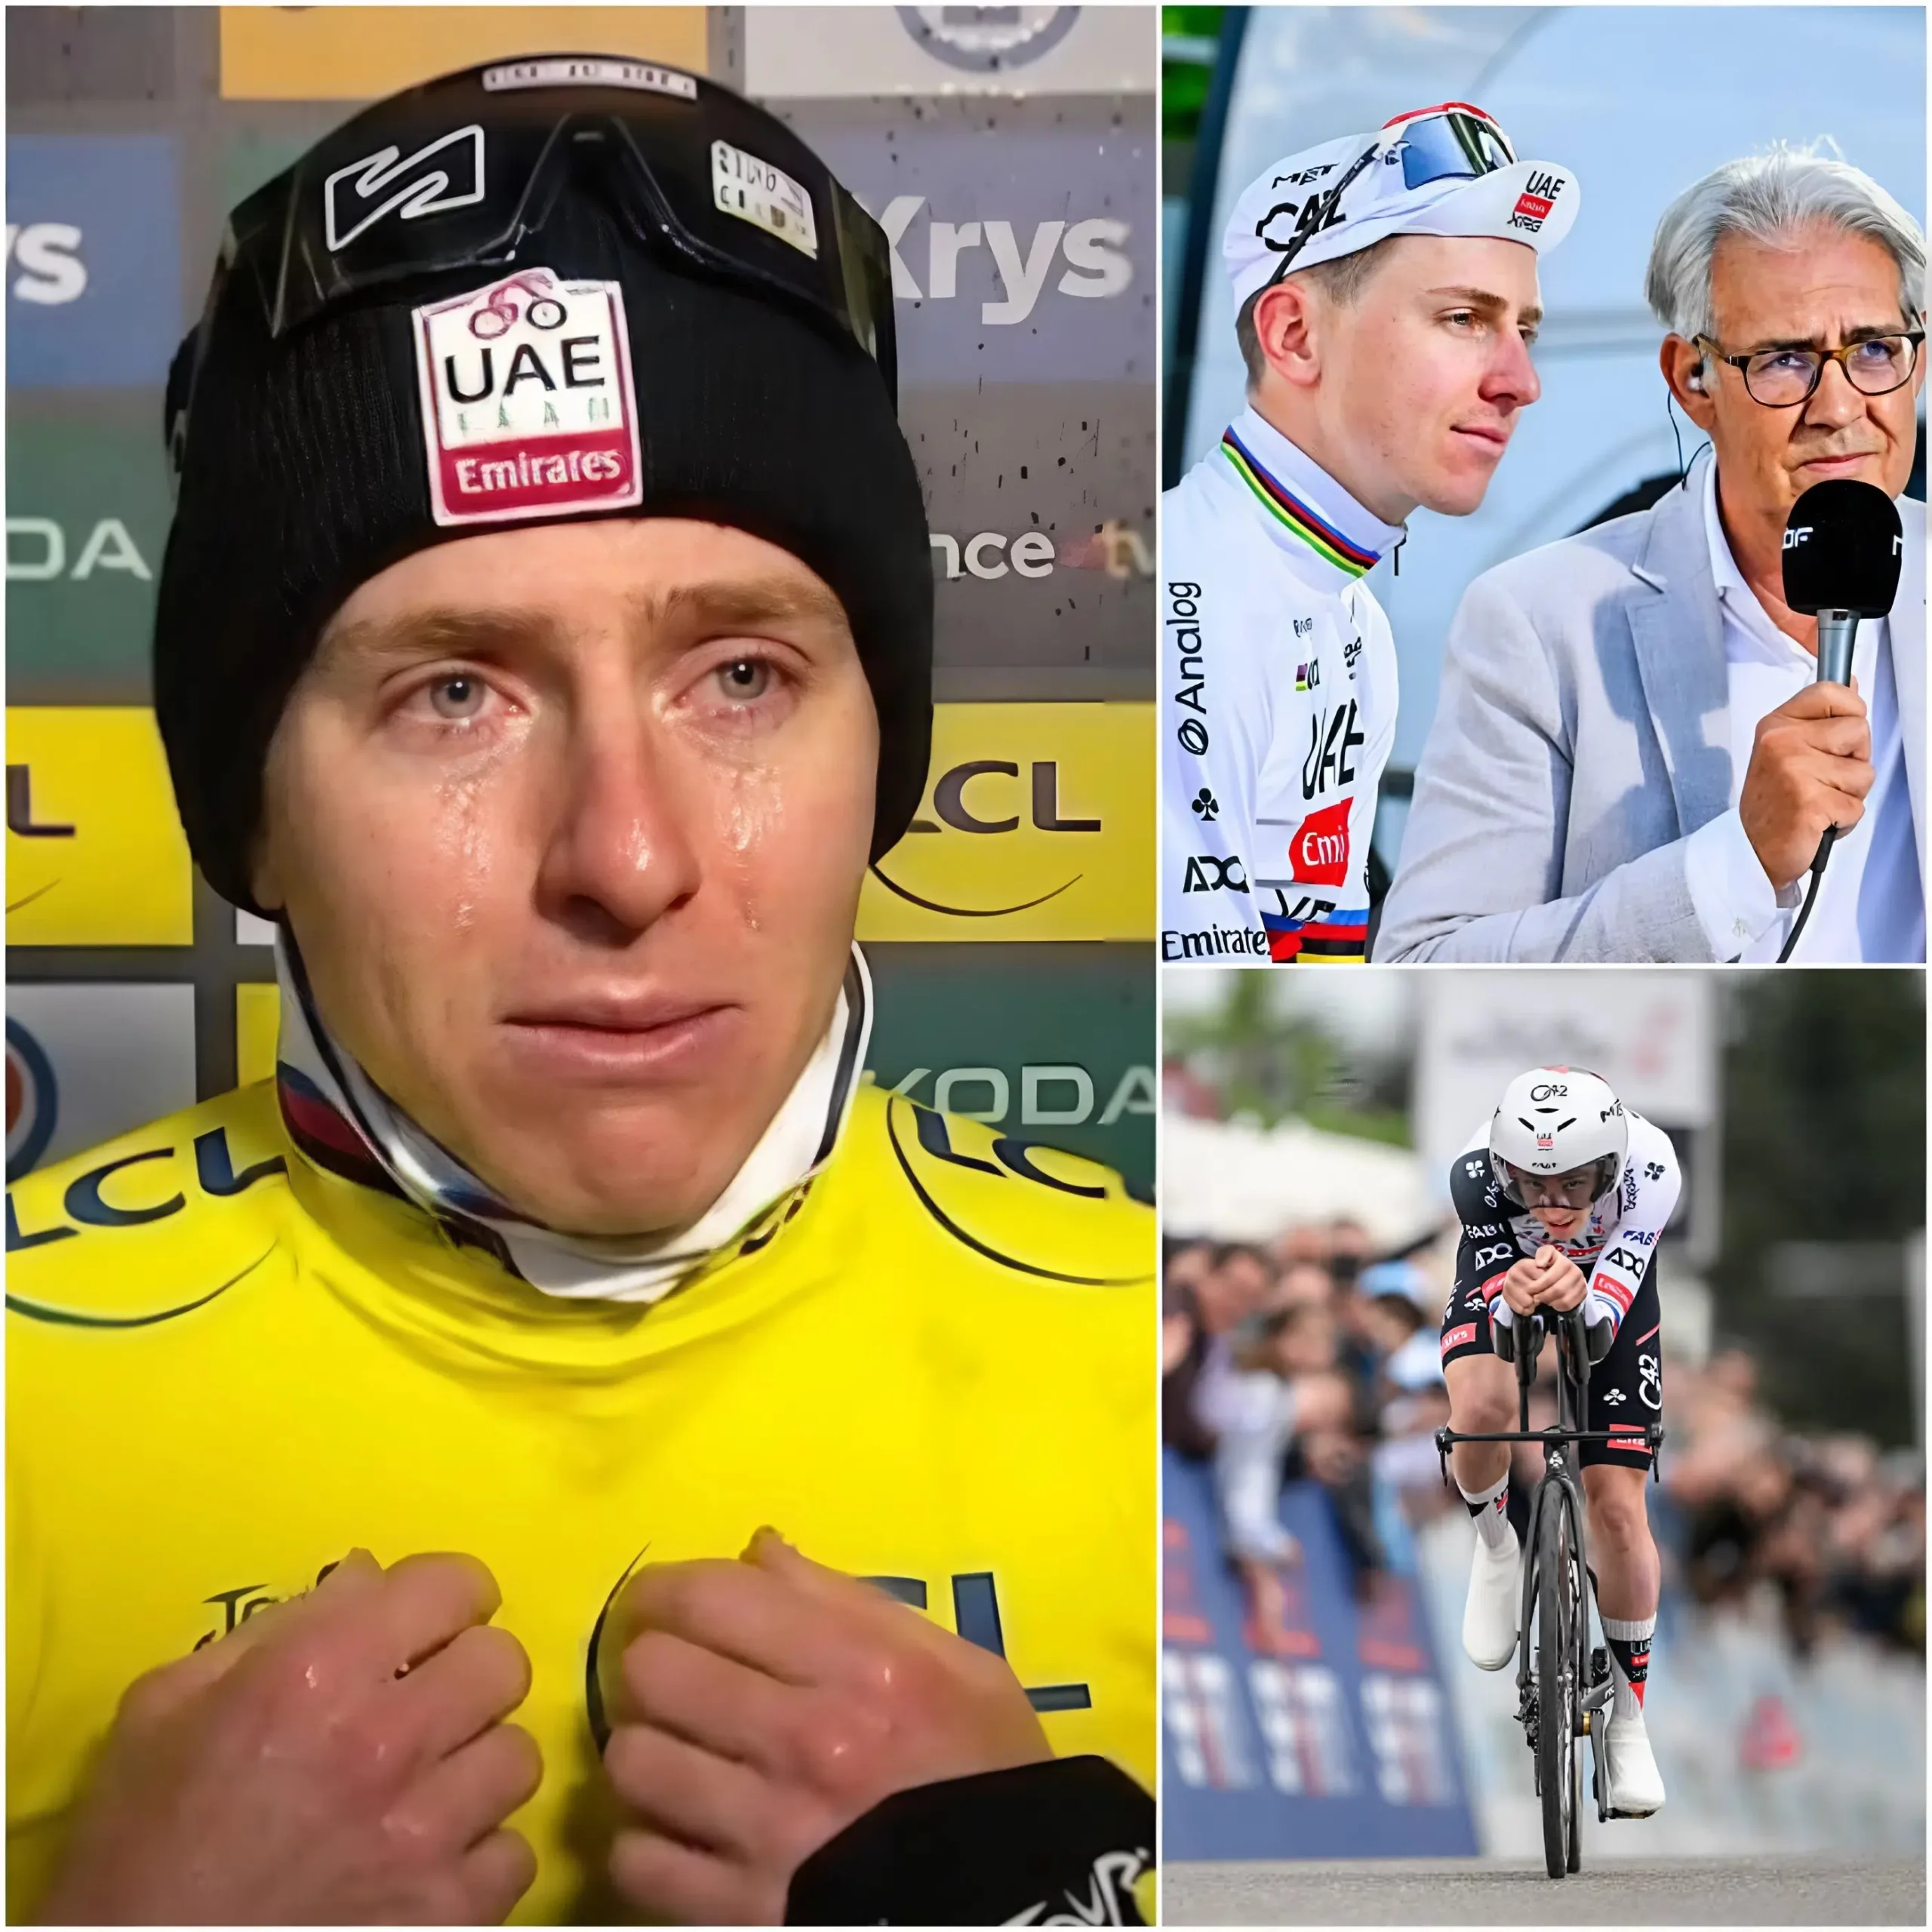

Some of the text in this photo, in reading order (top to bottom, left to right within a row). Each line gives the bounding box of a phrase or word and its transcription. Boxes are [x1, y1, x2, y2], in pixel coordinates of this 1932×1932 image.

[1525, 171, 1565, 200] UAE
[6, 223, 87, 304] s
[445, 336, 605, 403] UAE
[1166, 582, 1207, 715] Analog
[906, 760, 1101, 834] CL
[1162, 923, 1272, 961] Emirate
